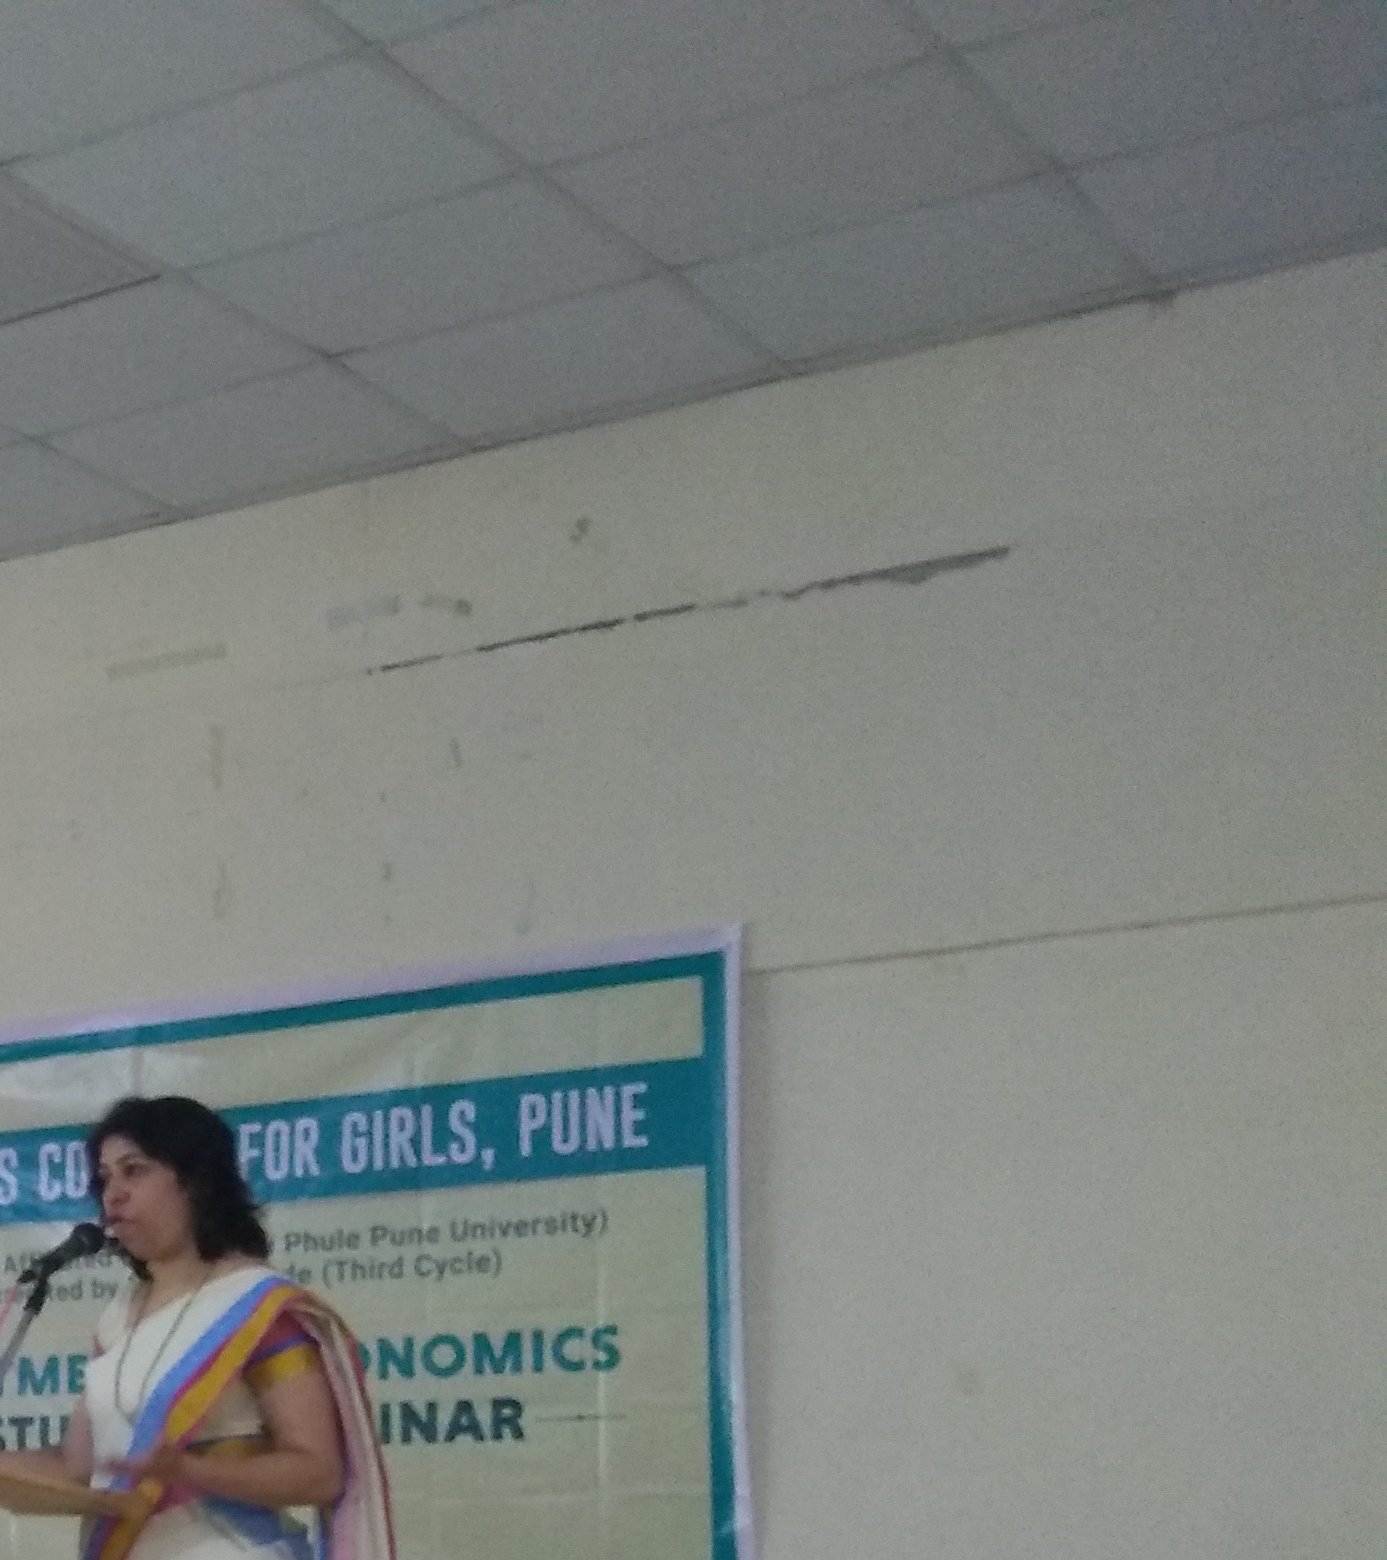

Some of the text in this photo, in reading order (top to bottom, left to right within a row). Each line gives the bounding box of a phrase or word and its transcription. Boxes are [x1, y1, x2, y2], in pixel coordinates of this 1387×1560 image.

[238, 1116, 320, 1181] FOR
[340, 1099, 495, 1174] GIRLS,
[519, 1081, 650, 1157] PUNE
[284, 1229, 361, 1252] Phule
[369, 1223, 441, 1248] Pune
[449, 1208, 609, 1238] University)
[91, 1278, 119, 1300] by
[322, 1256, 404, 1289] (Third
[414, 1247, 503, 1282] Cycle)
[359, 1325, 621, 1380] NOMICS
[380, 1396, 524, 1444] INAR
